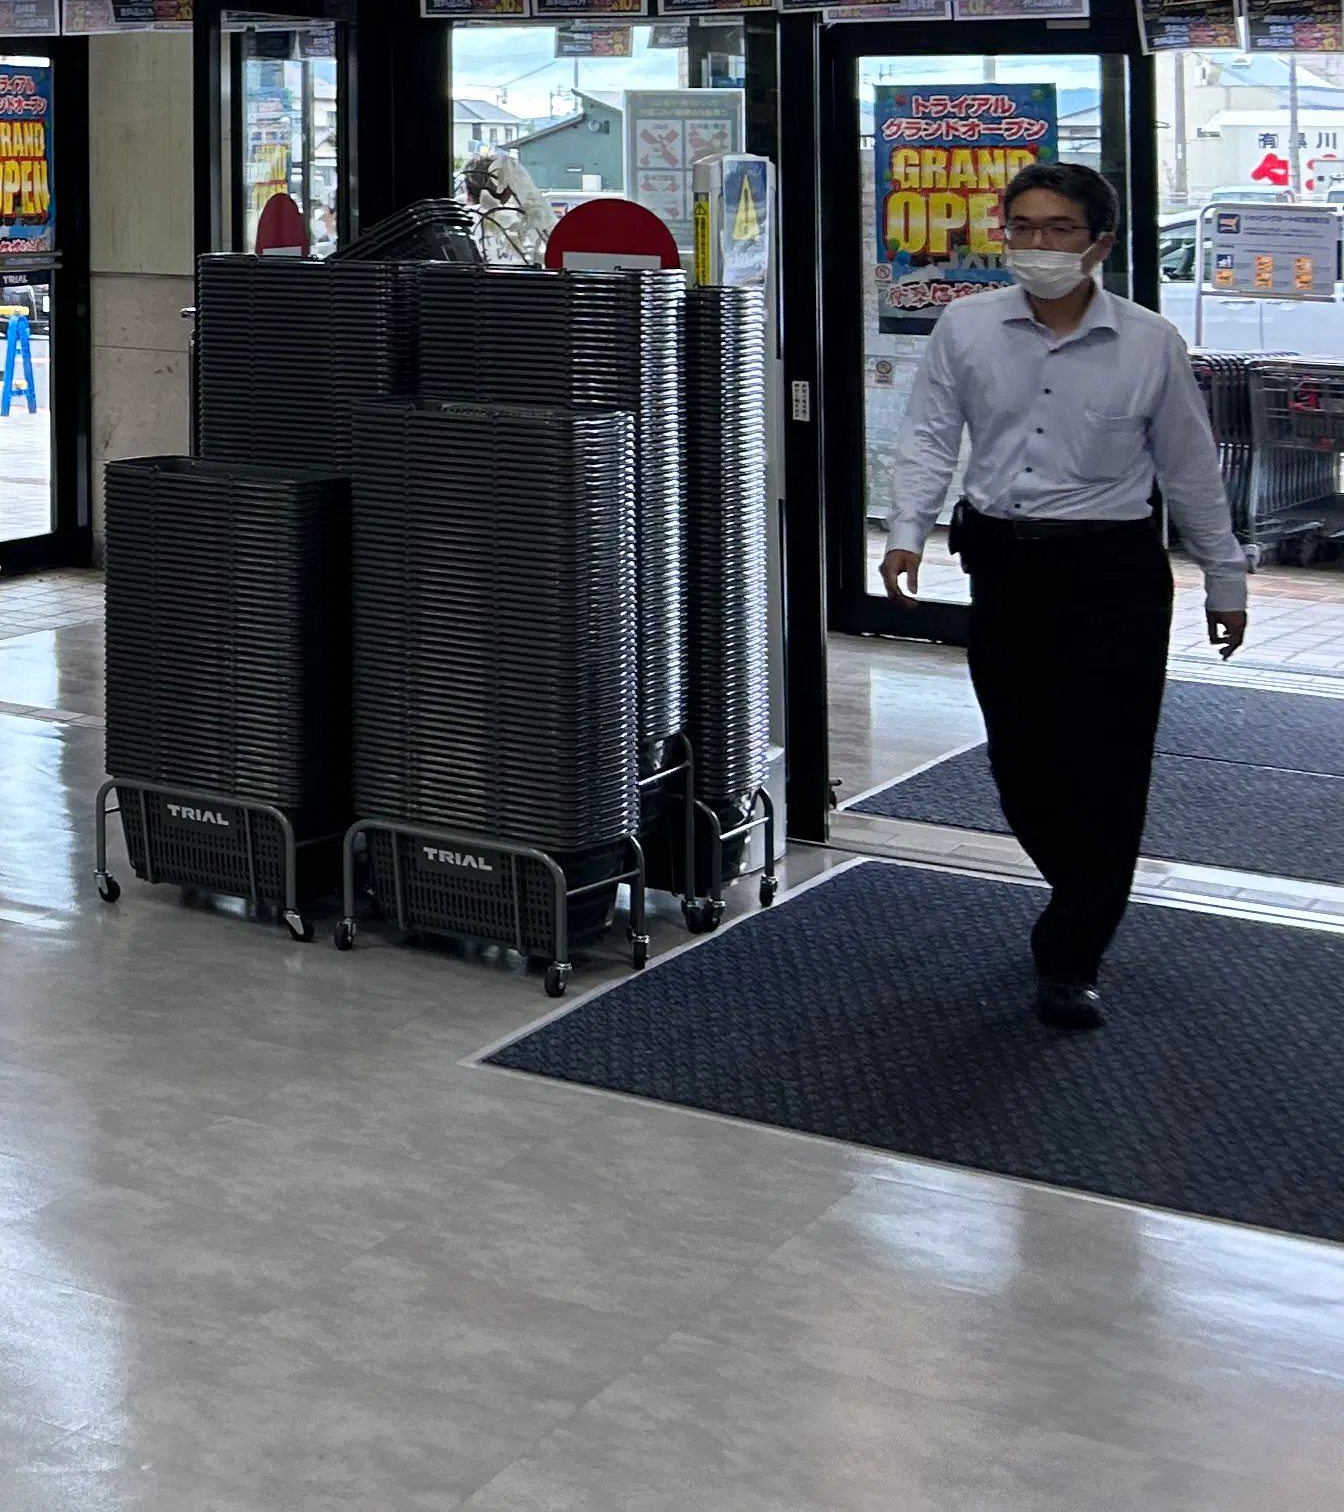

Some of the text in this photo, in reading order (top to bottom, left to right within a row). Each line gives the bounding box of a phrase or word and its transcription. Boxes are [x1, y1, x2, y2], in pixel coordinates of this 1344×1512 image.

[913, 95, 1015, 116] トライアル
[882, 118, 1049, 140] グランドオープン
[3, 275, 29, 284] TRIAL
[167, 804, 229, 826] TRIAL
[423, 847, 493, 871] TRIAL
